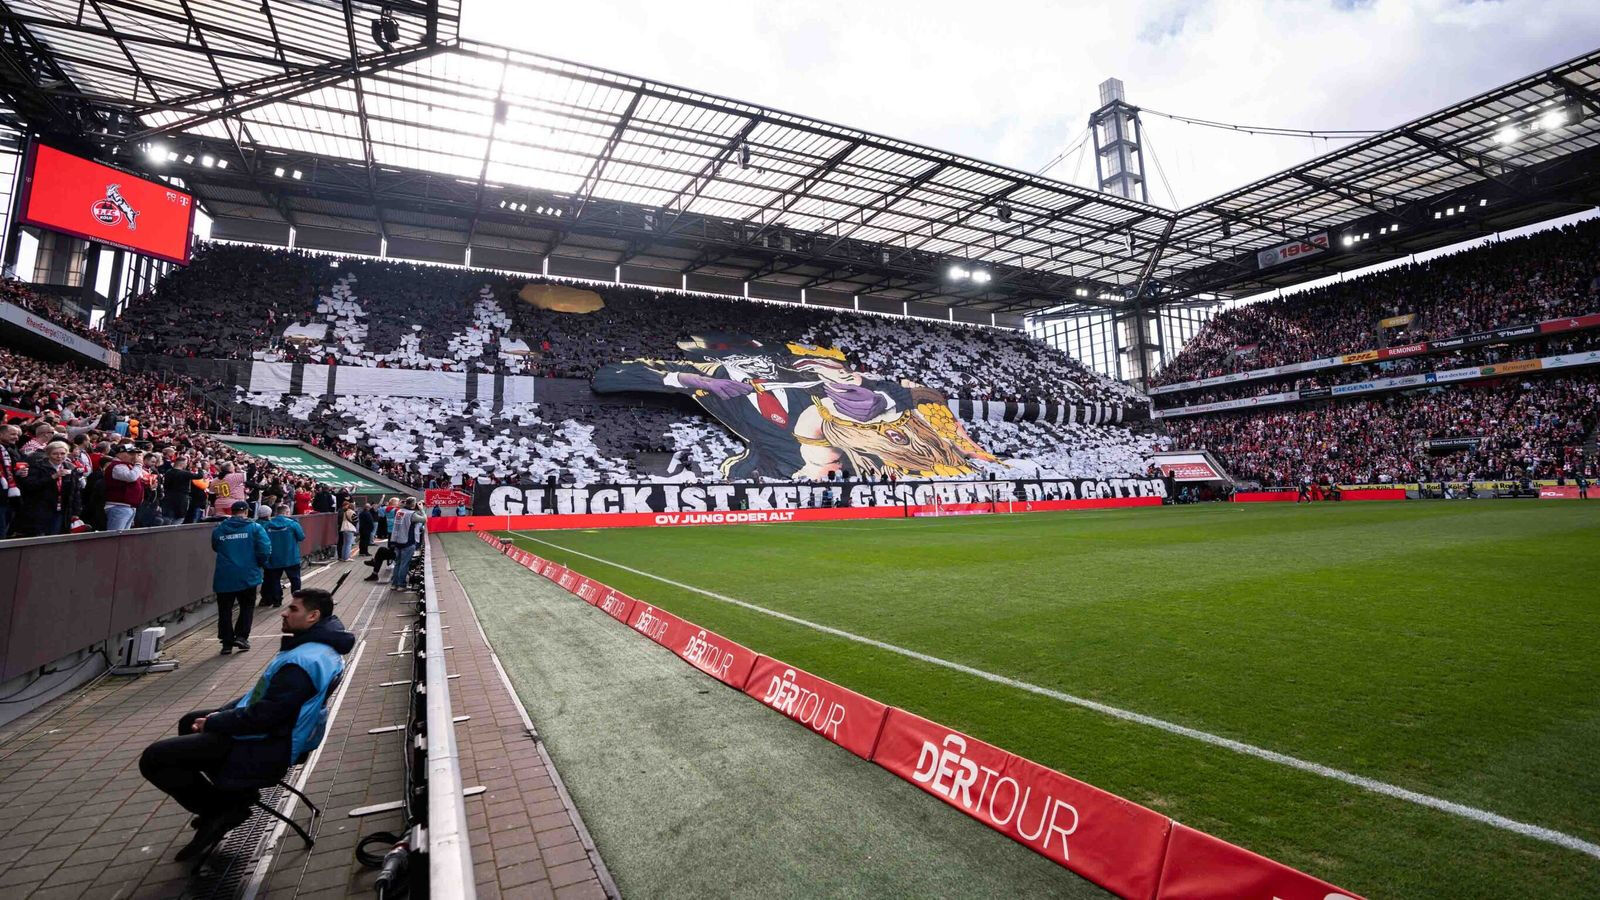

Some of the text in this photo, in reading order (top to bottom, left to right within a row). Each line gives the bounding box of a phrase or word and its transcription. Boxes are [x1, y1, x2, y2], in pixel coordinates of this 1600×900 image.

[1506, 326, 1535, 338] hummel
[1439, 338, 1464, 348] hummel
[1388, 345, 1421, 356] REMONDIS
[1347, 353, 1374, 363] DHL
[1333, 383, 1375, 394] SIEGENIA
[489, 482, 653, 517] GLÜCK
[663, 484, 735, 513] IST
[850, 482, 1020, 509] GESCHENK
[1024, 481, 1075, 502] DER
[1079, 476, 1167, 499] GÖTTER
[655, 511, 794, 525] OV JUNG ODER ALT
